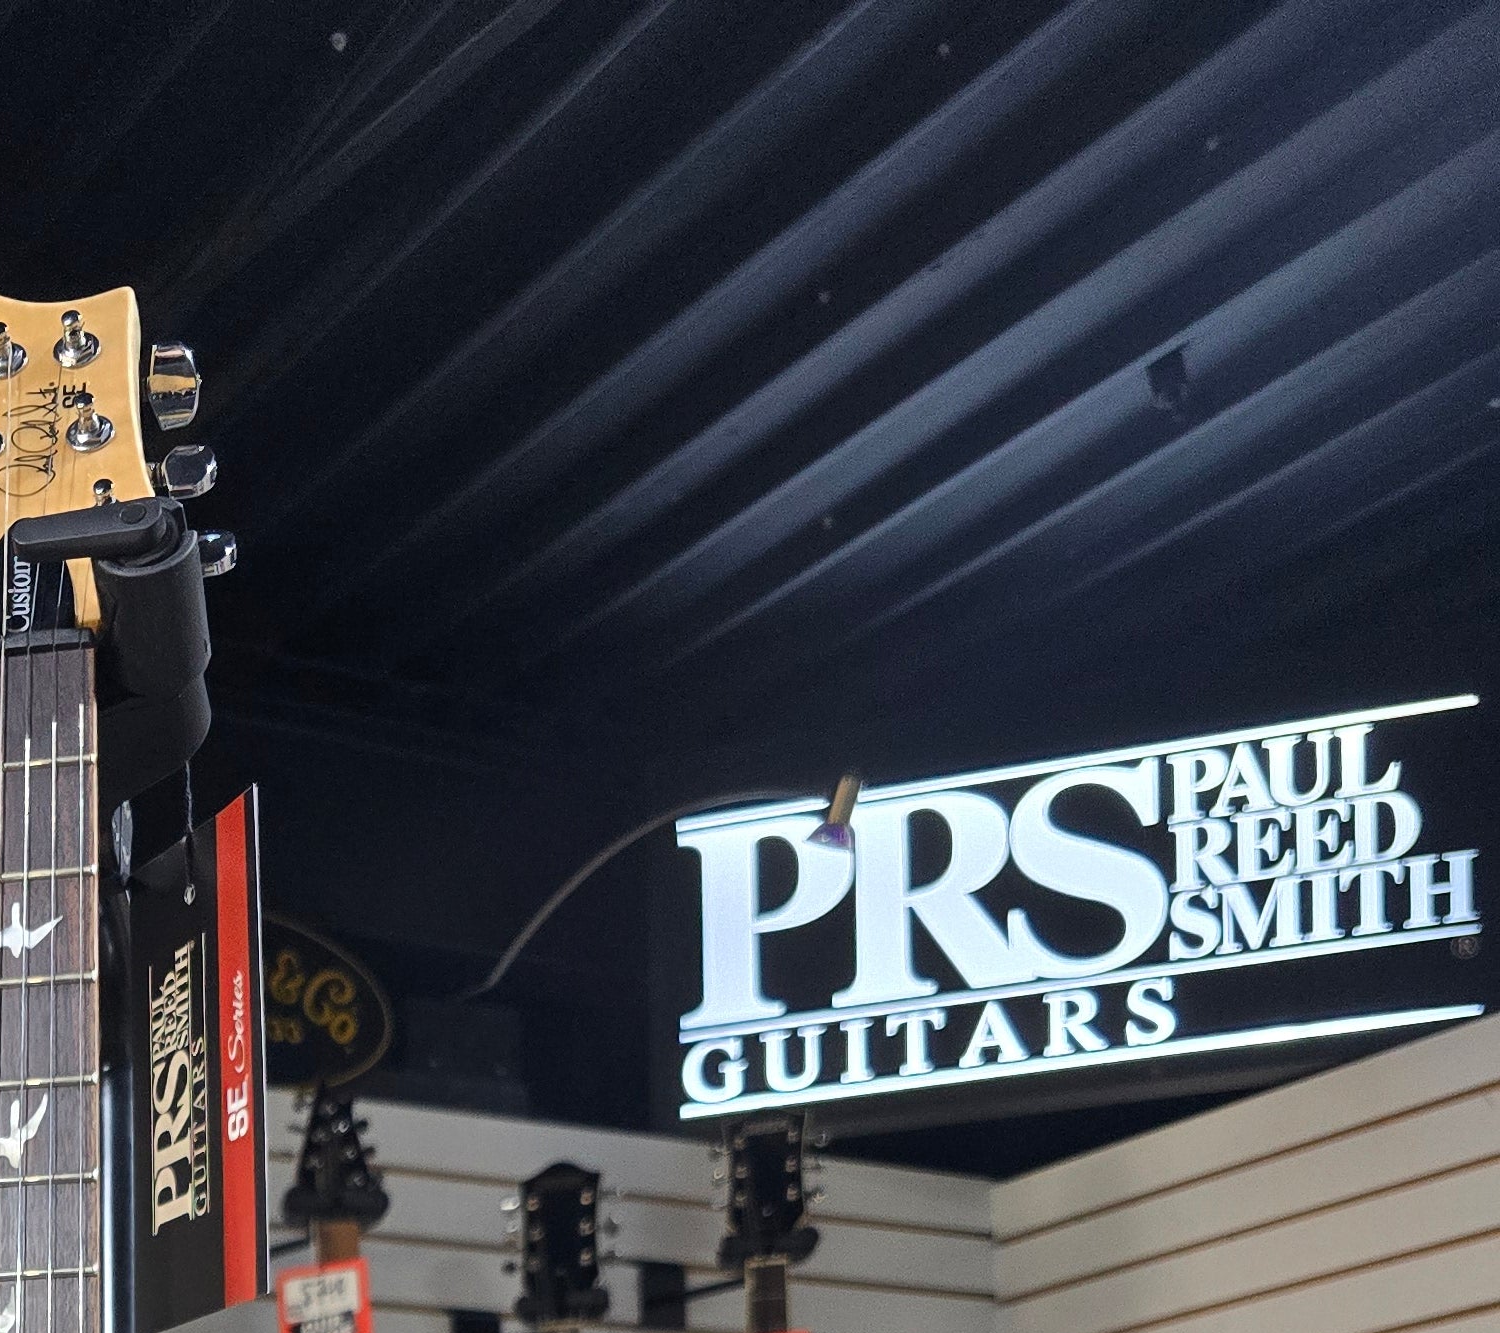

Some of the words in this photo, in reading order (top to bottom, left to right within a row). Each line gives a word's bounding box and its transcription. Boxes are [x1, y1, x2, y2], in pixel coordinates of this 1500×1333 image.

[1166, 722, 1403, 826] PAUL
[1169, 789, 1424, 893] REED
[678, 757, 1169, 1030] PRS
[1168, 849, 1481, 961] SMITH
[152, 987, 165, 1064] PAUL
[163, 970, 177, 1056] REED
[175, 944, 189, 1049] SMITH
[227, 969, 245, 1073] Series
[681, 977, 1179, 1105] GUITARS
[153, 1050, 192, 1236] PRS
[192, 1036, 207, 1216] GUITARS
[227, 1078, 249, 1142] SE
